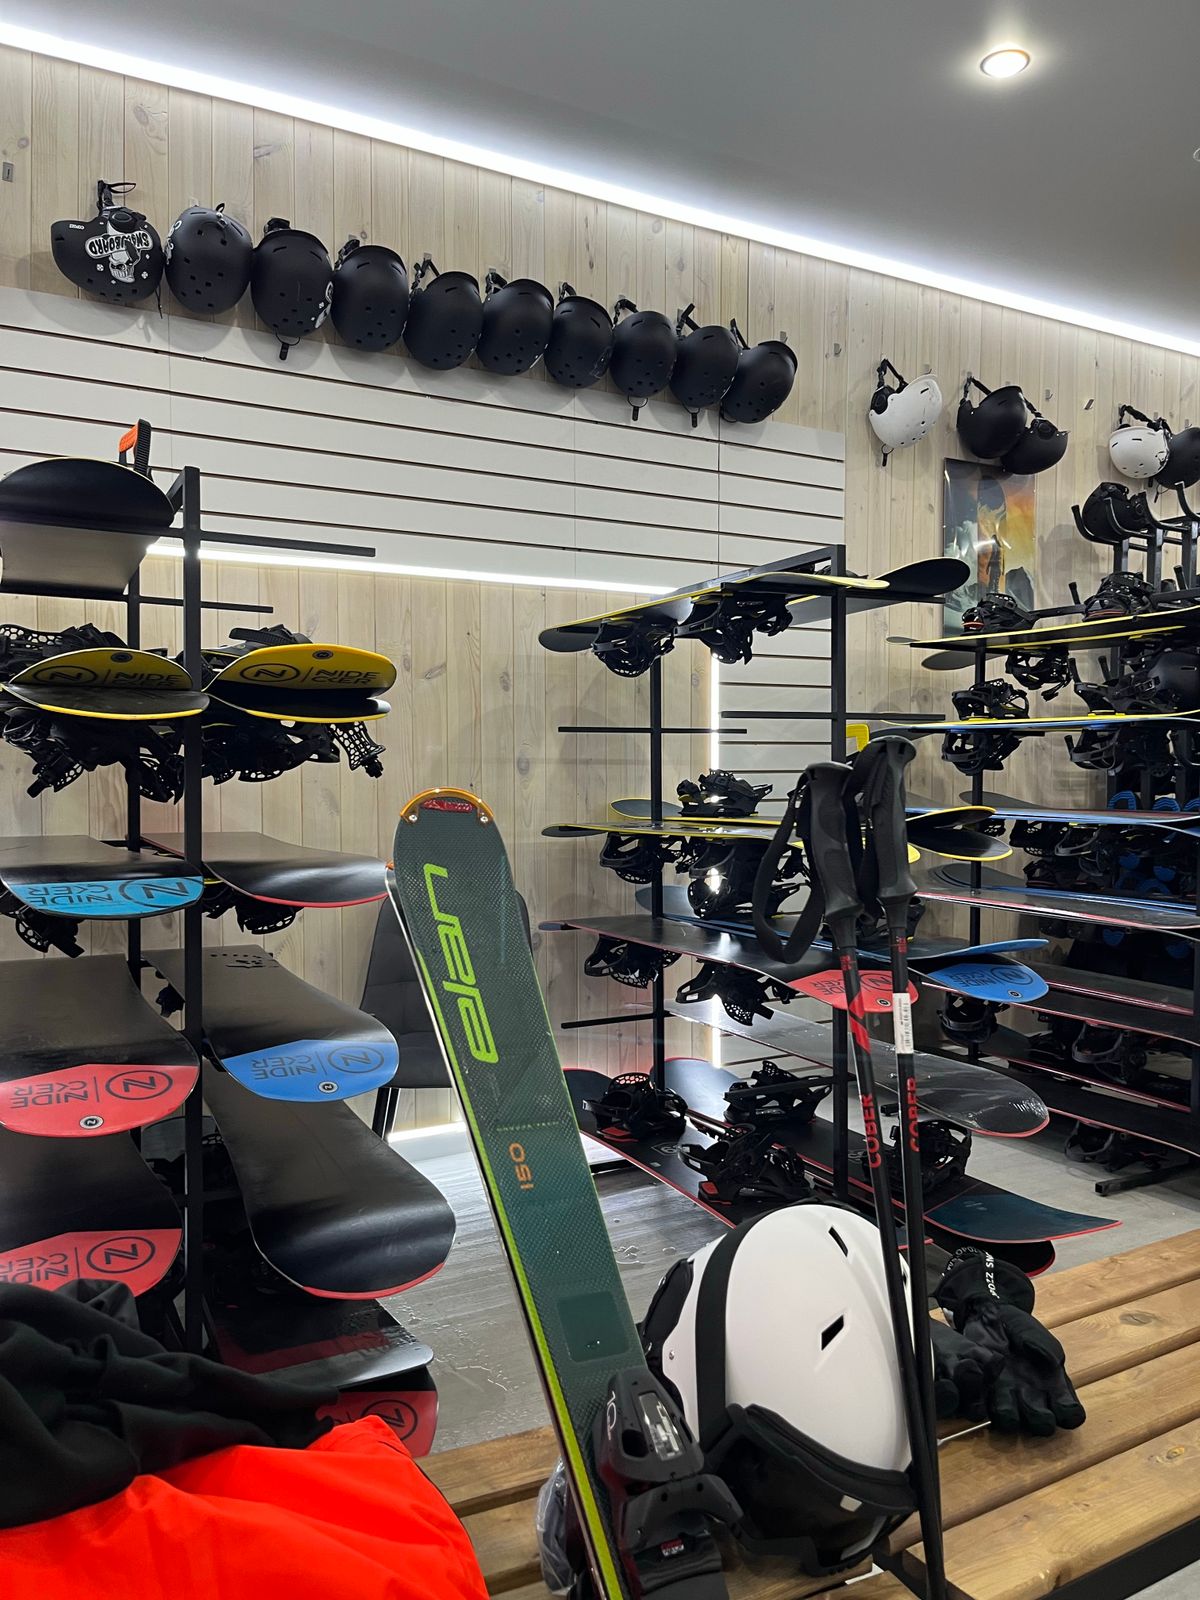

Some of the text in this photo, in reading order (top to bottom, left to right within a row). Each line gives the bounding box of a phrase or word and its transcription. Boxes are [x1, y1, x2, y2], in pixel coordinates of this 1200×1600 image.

[89, 231, 150, 254] SNOWBOARD
[114, 671, 184, 681] NIDE
[315, 669, 381, 678] NIDE
[30, 893, 114, 906] NIDE
[253, 1064, 318, 1080] NIDE
[9, 1090, 89, 1109] NIDE
[862, 1092, 883, 1169] COBER
